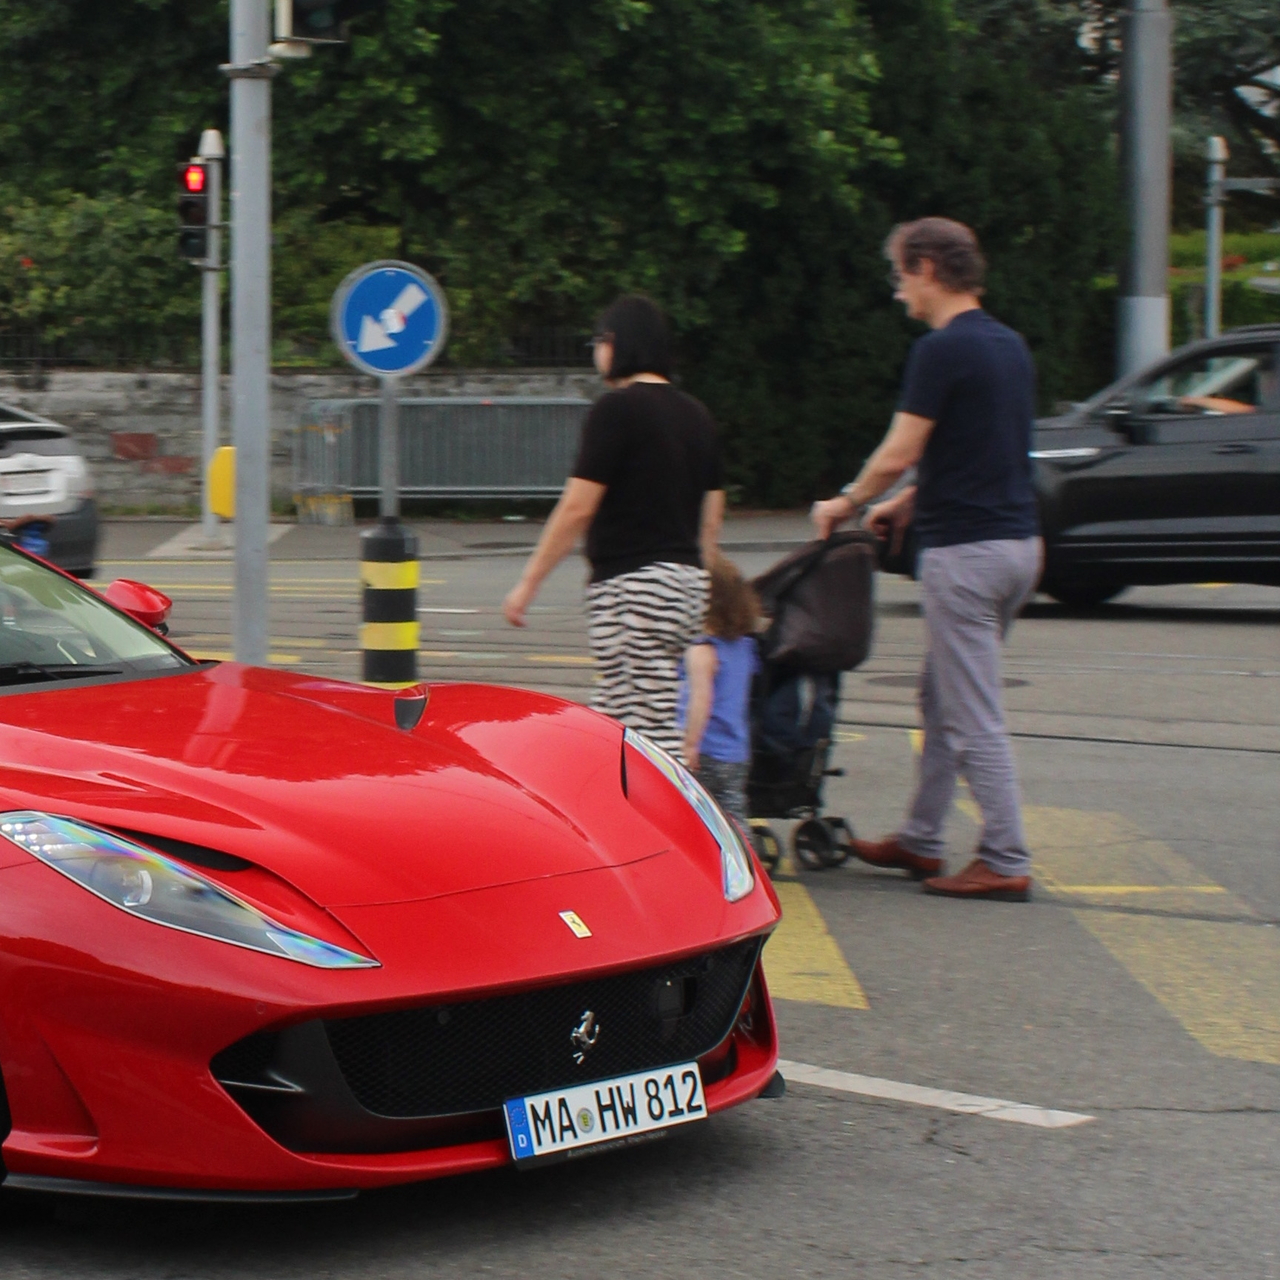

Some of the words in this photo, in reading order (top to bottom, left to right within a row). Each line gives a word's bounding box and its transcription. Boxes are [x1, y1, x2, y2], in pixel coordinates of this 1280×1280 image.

[519, 1133, 528, 1148] D
[529, 1097, 578, 1147] MA
[594, 1082, 638, 1133] HW
[644, 1070, 703, 1121] 812
